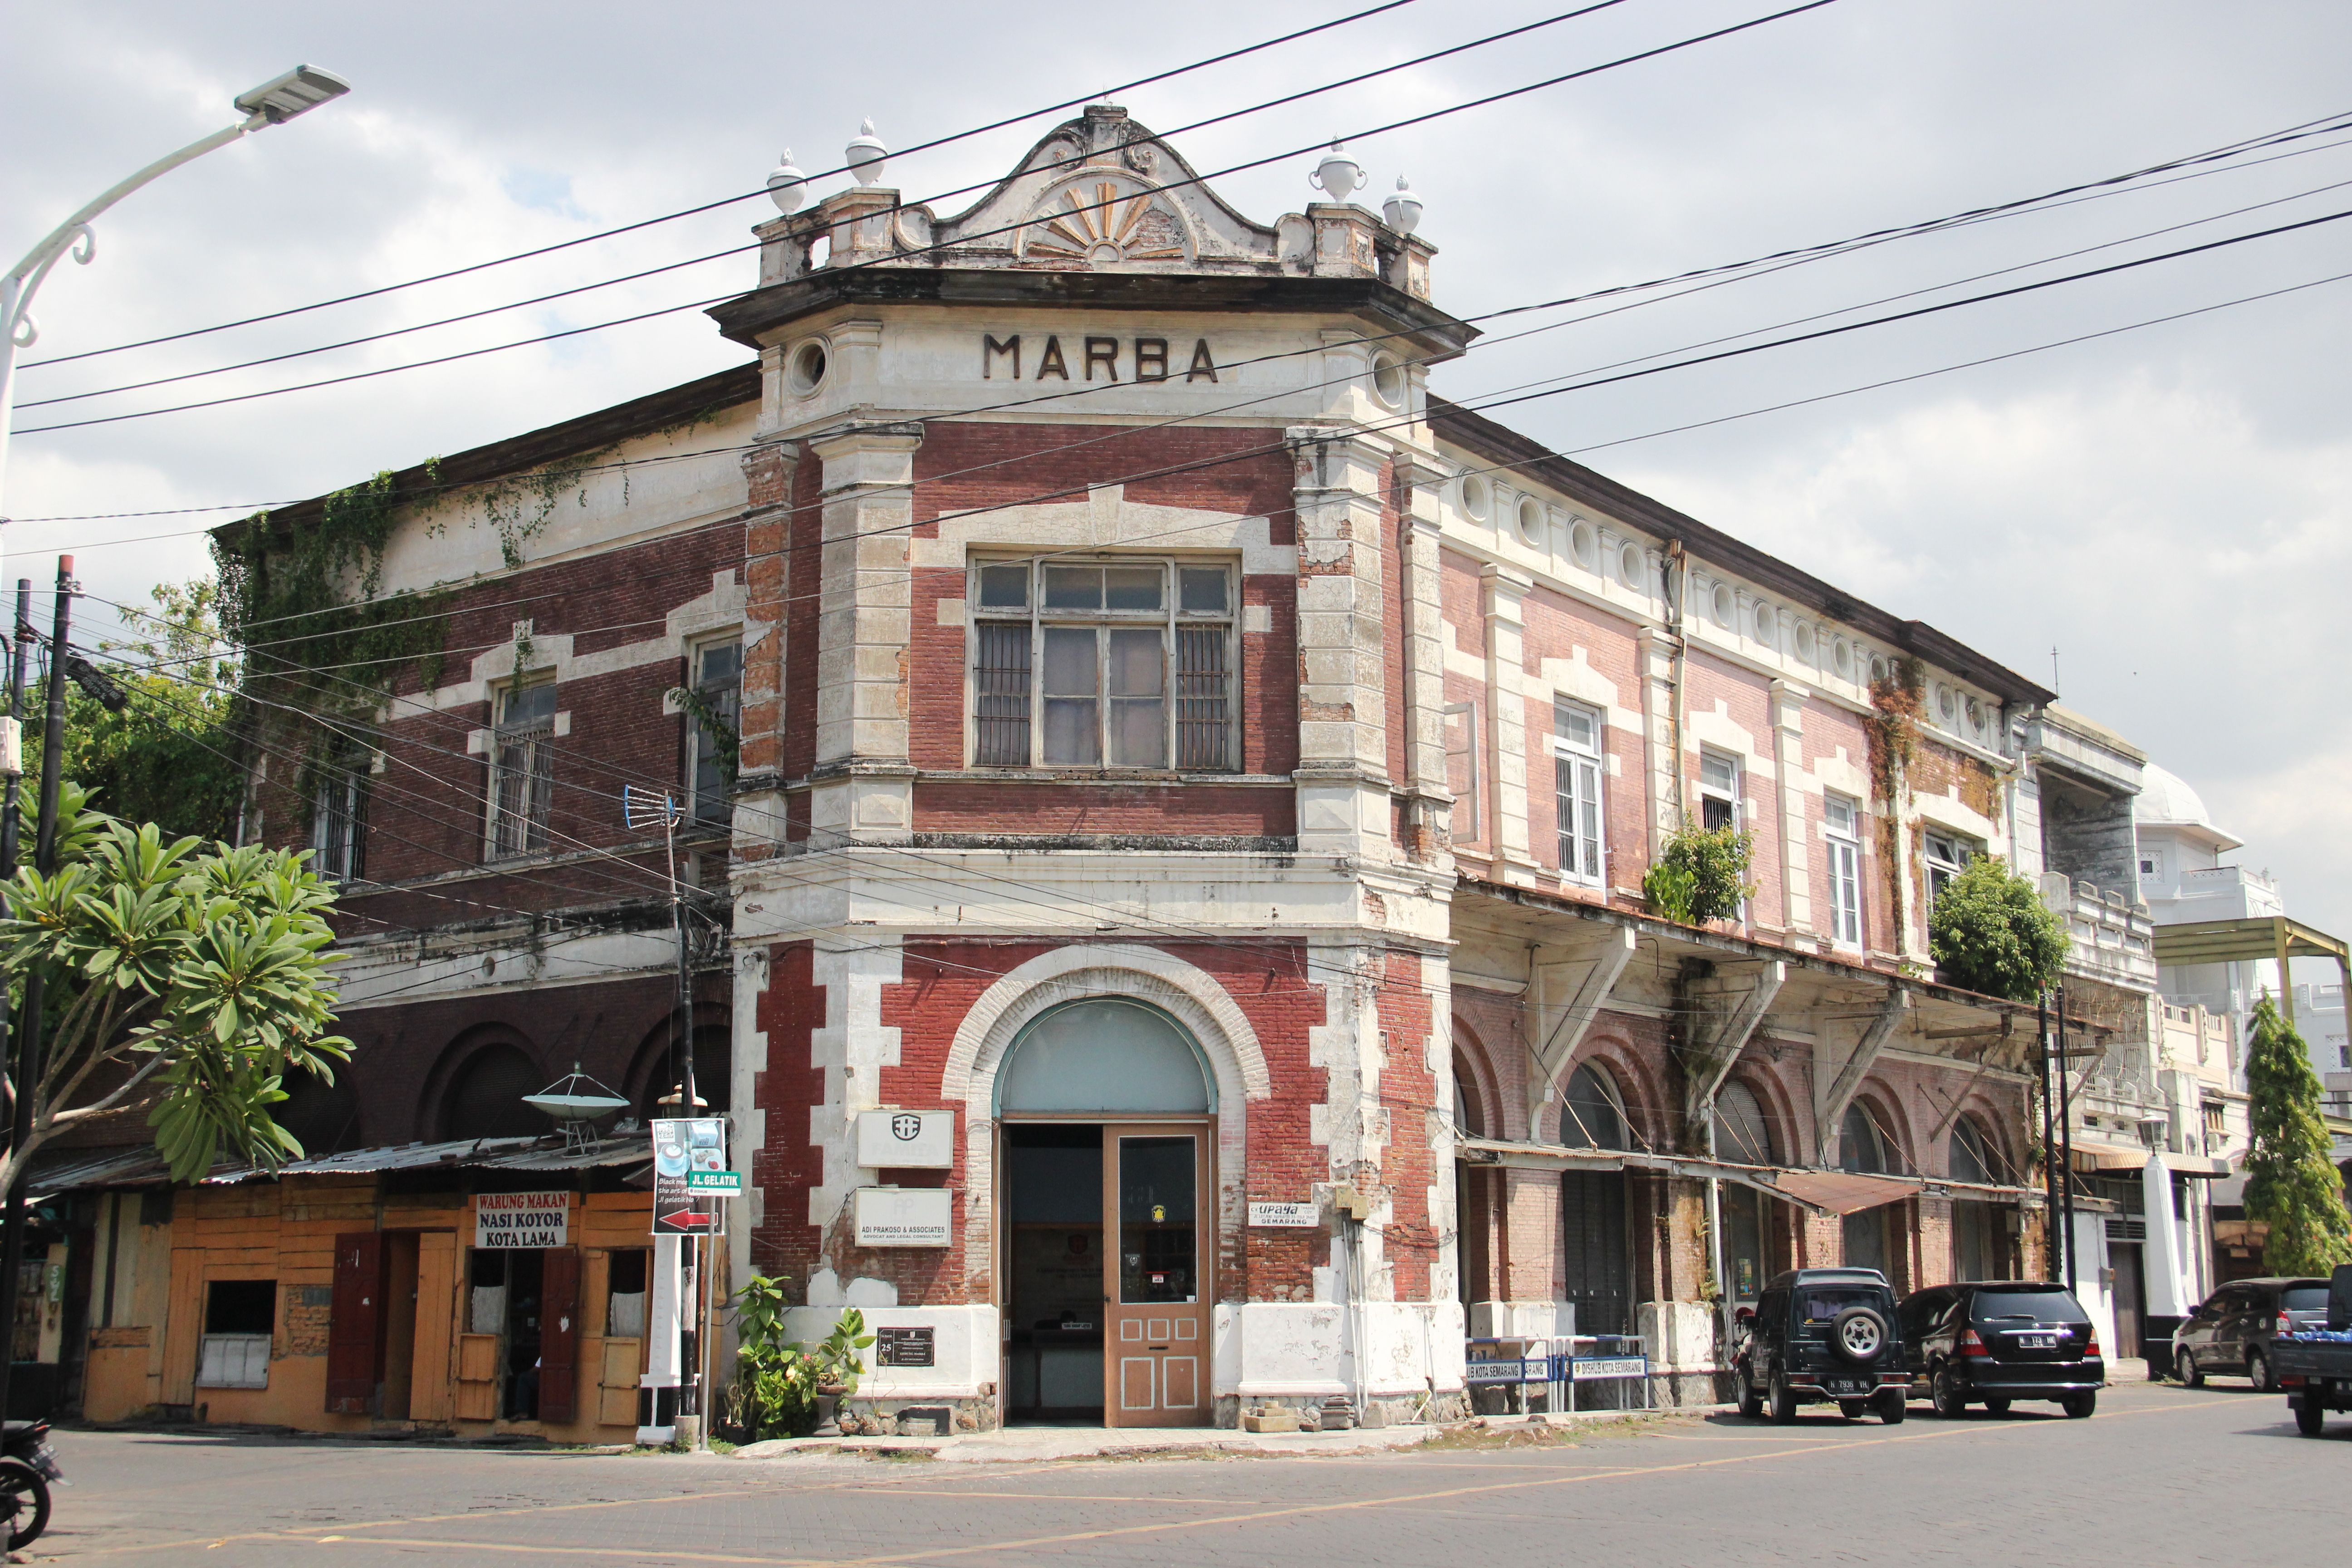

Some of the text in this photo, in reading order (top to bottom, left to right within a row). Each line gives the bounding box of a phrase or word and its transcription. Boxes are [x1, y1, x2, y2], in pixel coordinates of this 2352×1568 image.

[984, 333, 1218, 382] MARBA
[692, 1174, 739, 1186] JL. GELATIK
[479, 1193, 567, 1209] WARUNG MAKAN
[480, 1212, 564, 1228] NASI KOYOR
[486, 1231, 557, 1246] KOTA LAMA
[1475, 1366, 1489, 1377] KOTA
[1490, 1365, 1518, 1377] SEMARANG
[1582, 1362, 1641, 1374] DISHUB KOTA SEMARANG
